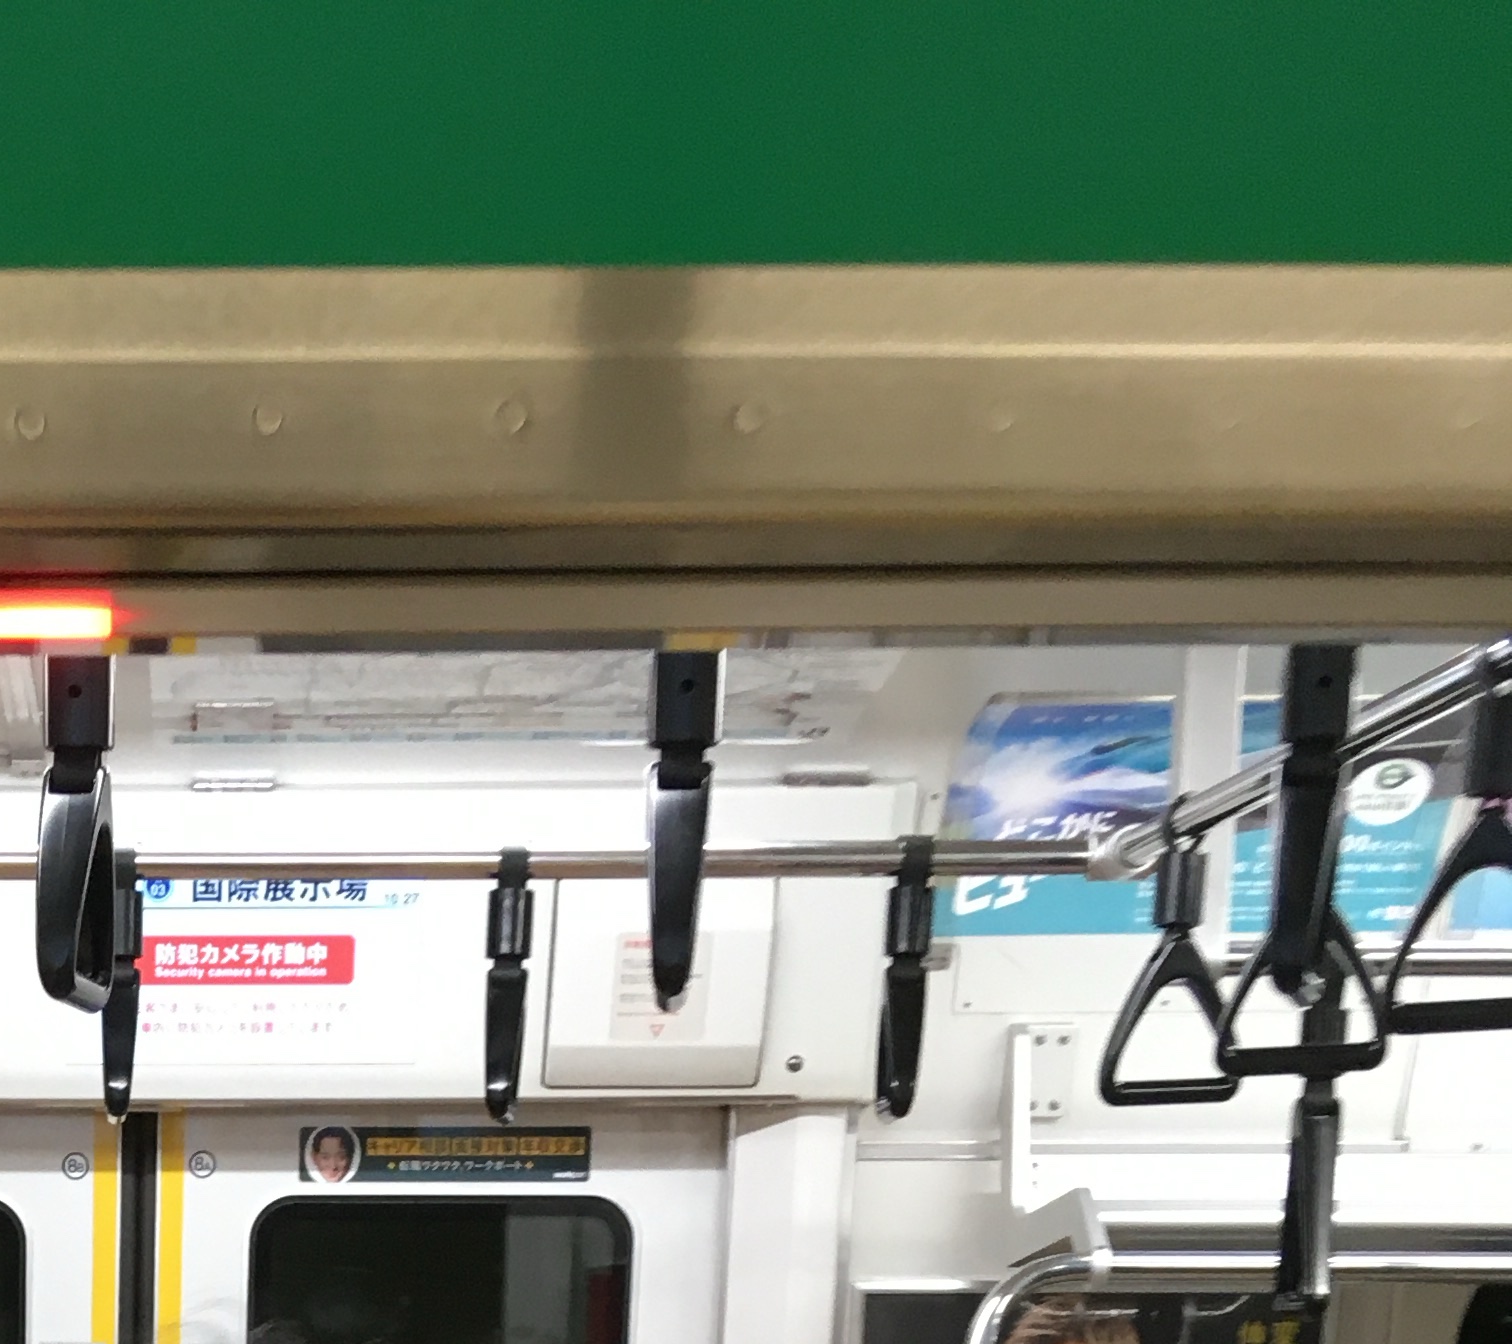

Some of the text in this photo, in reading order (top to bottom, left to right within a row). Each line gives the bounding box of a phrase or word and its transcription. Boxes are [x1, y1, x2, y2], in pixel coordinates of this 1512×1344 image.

[154, 942, 329, 966] 防犯カメラ作動中
[154, 966, 327, 980] Security camera in operation
